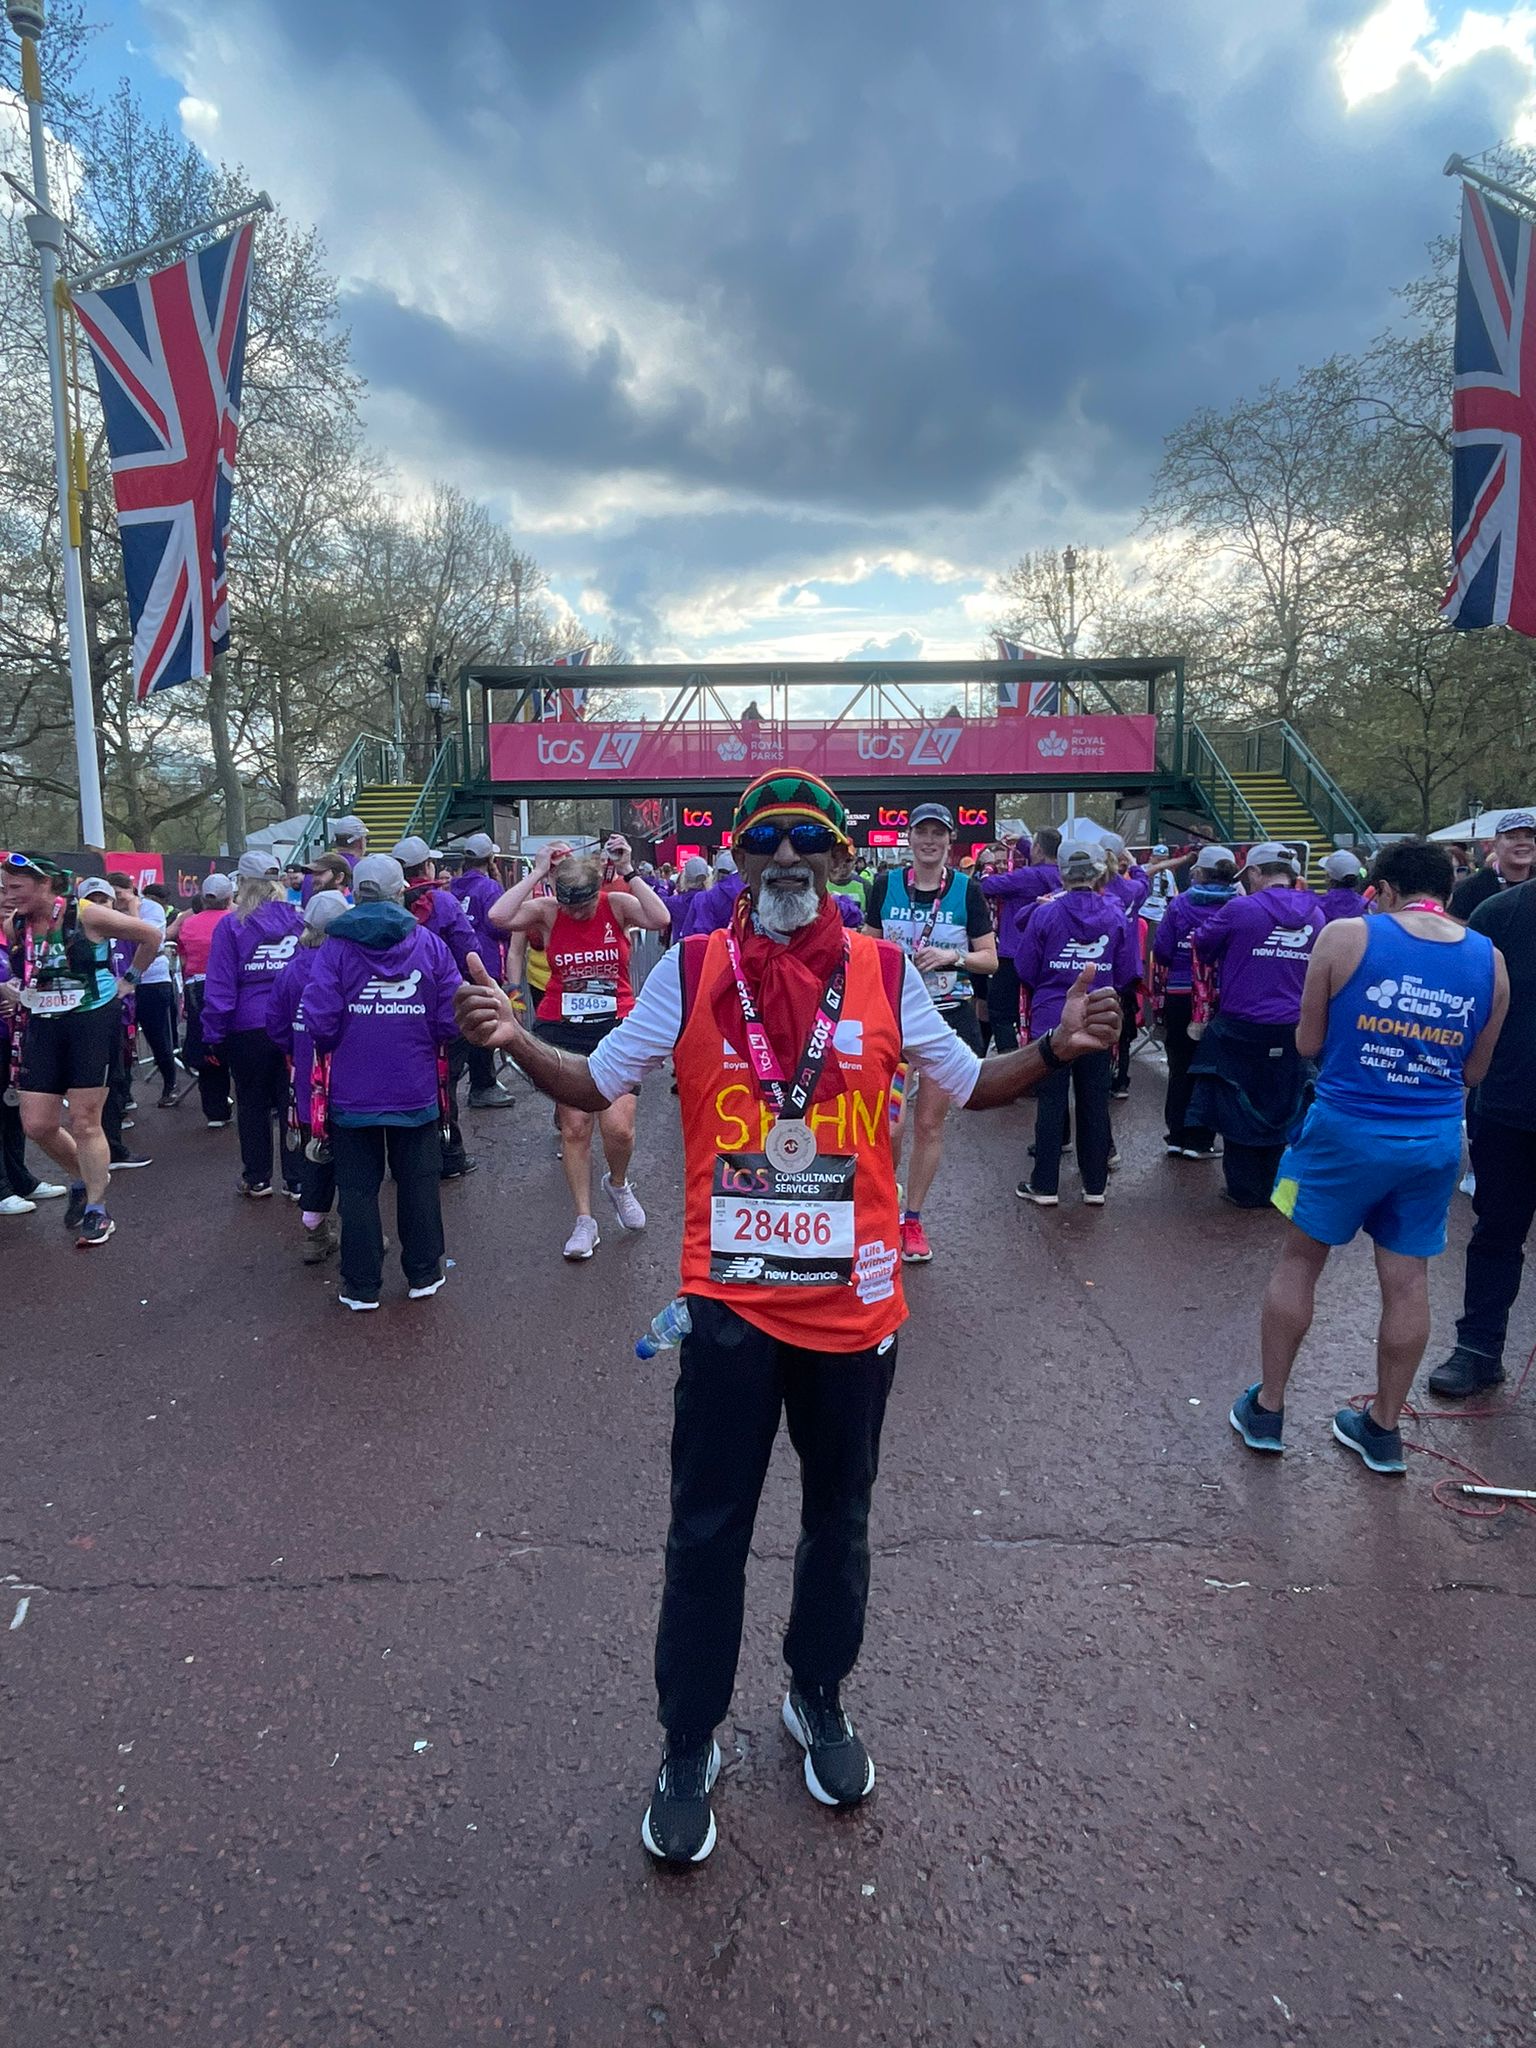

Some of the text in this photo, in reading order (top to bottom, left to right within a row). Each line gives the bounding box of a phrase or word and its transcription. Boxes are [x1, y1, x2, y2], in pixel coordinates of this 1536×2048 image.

[751, 741, 784, 750] ROYAL
[857, 730, 904, 760] tcs
[1072, 736, 1105, 745] ROYAL
[537, 734, 585, 764] tcs
[751, 751, 784, 760] PARKS
[1072, 747, 1105, 756] PARKS
[683, 807, 713, 827] tcs
[879, 806, 909, 826] tcs
[959, 806, 988, 826] tcs
[554, 948, 619, 967] SPERRIN
[1252, 947, 1311, 960] new balanc
[244, 961, 265, 971] new
[1050, 960, 1112, 971] new bance
[1399, 981, 1464, 1010] Running
[348, 1003, 373, 1014] new
[1397, 997, 1442, 1018] Club
[1356, 1014, 1465, 1046] MOHAMED
[807, 1018, 832, 1060] 2023
[1361, 1042, 1405, 1058] AHMED
[1360, 1056, 1397, 1069] SALEH
[1387, 1072, 1420, 1085] HANA
[721, 1161, 846, 1192] tcs CONSULTANCY
[775, 1184, 821, 1194] SERVICES
[734, 1208, 831, 1246] 28486
[765, 1270, 789, 1280] new
[790, 1270, 838, 1281] balance
[863, 1267, 891, 1282] Limits
